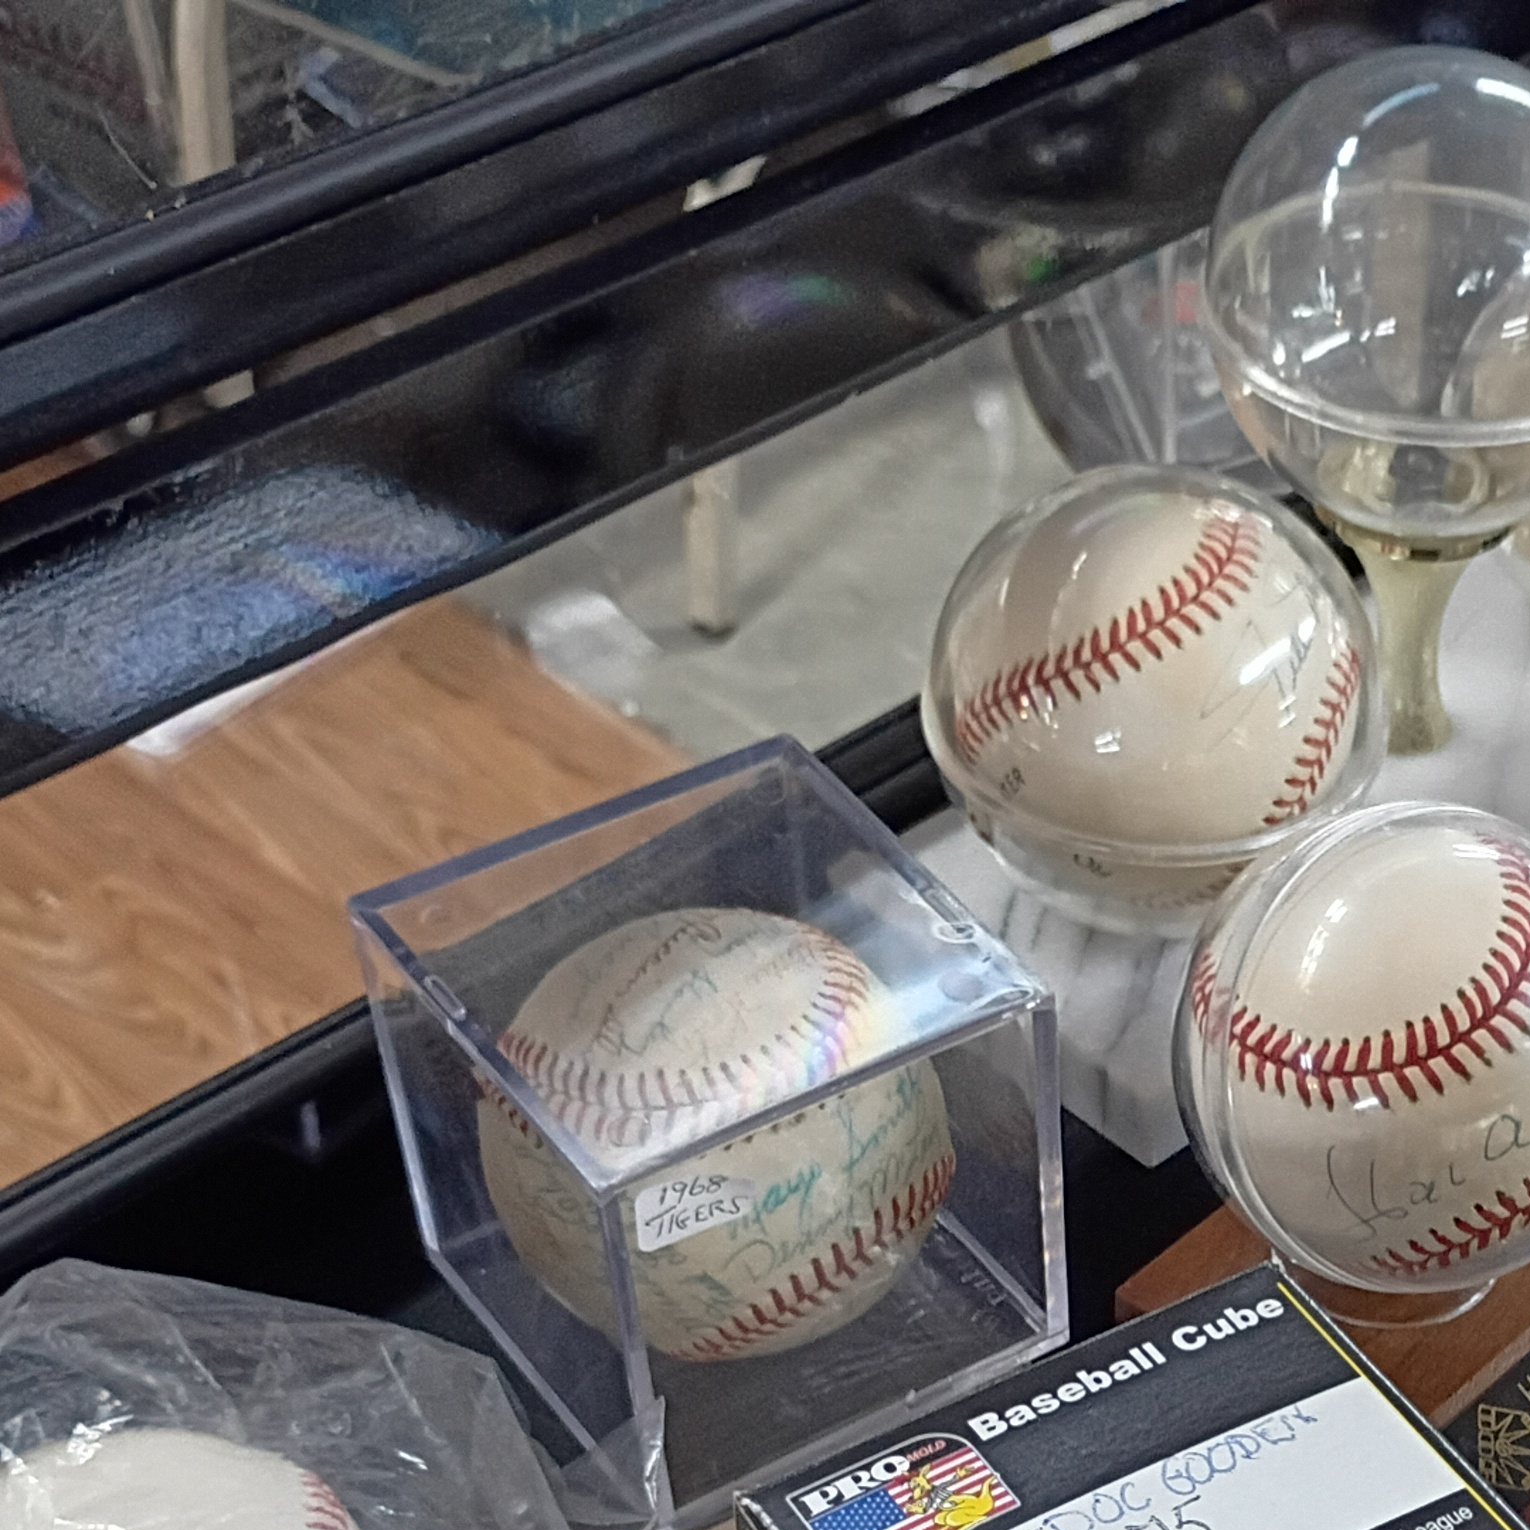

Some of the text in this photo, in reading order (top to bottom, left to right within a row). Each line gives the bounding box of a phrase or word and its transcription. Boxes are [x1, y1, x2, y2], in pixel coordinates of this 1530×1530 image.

[657, 1174, 730, 1205] 1968
[644, 1194, 744, 1238] TIGERS
[966, 1293, 1286, 1443] Baseball Cube
